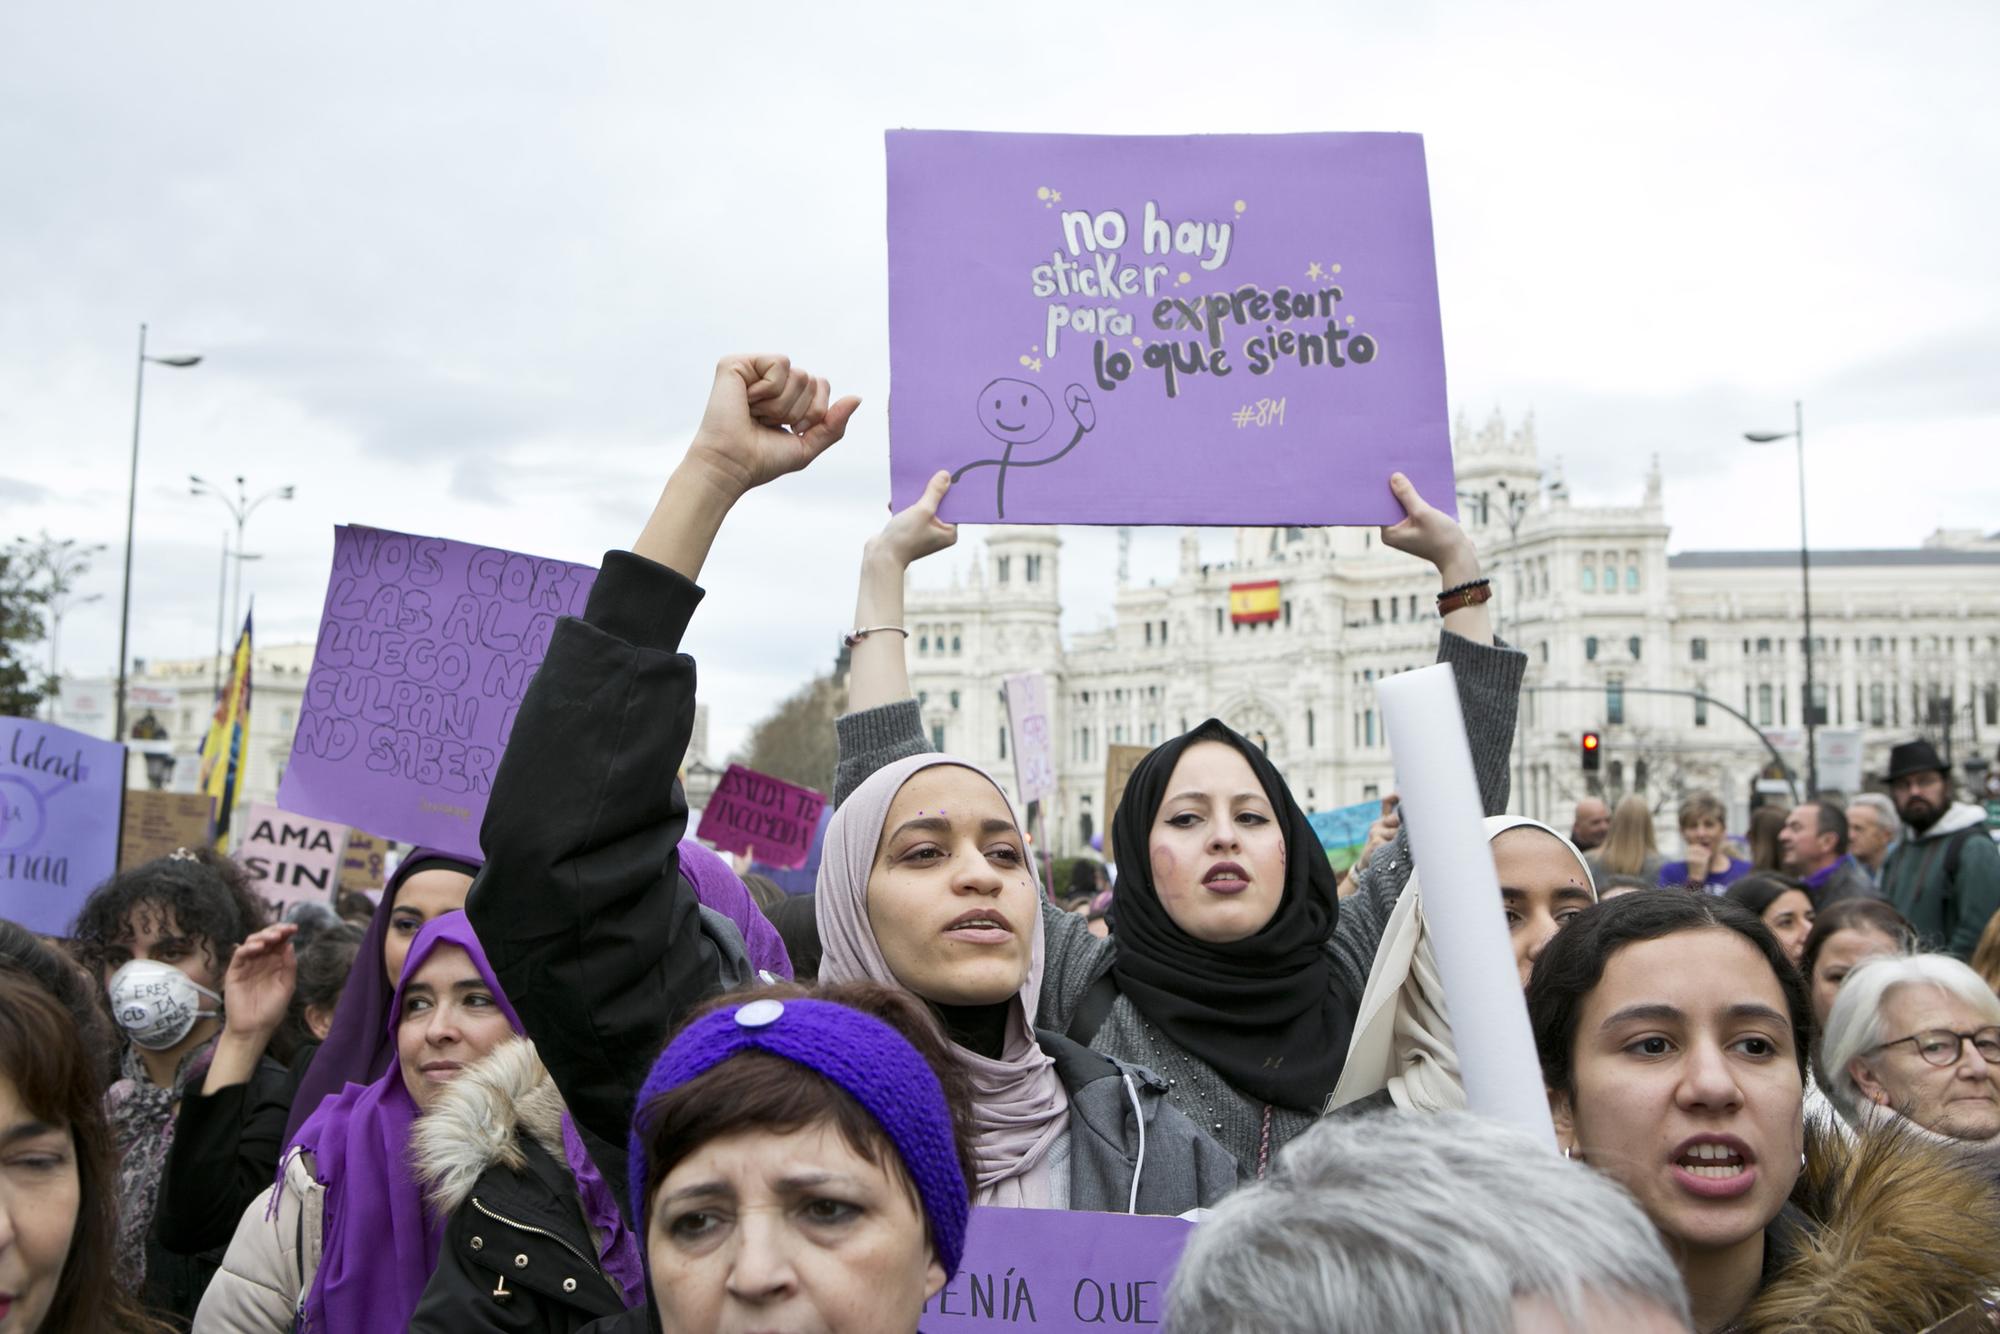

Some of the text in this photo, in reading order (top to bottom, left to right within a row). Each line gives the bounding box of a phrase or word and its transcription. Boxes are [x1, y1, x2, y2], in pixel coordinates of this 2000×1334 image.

[1061, 200, 1233, 270] no hay
[1032, 249, 1169, 299] sticker
[1045, 284, 1346, 359] para expresar
[1094, 319, 1378, 399] lo que siento
[1231, 396, 1287, 429] #8M
[334, 527, 447, 587] NOS
[329, 577, 433, 635] LAS
[316, 621, 543, 702] LUEGO N
[306, 667, 480, 741] CULPAN
[294, 710, 358, 761] NO
[365, 723, 495, 795] SABER
[250, 820, 334, 853] AMA
[0, 849, 68, 887] ncia
[244, 856, 330, 891] SIN
[133, 982, 169, 999] ERES
[922, 1267, 1159, 1324] ENÍA QUE
